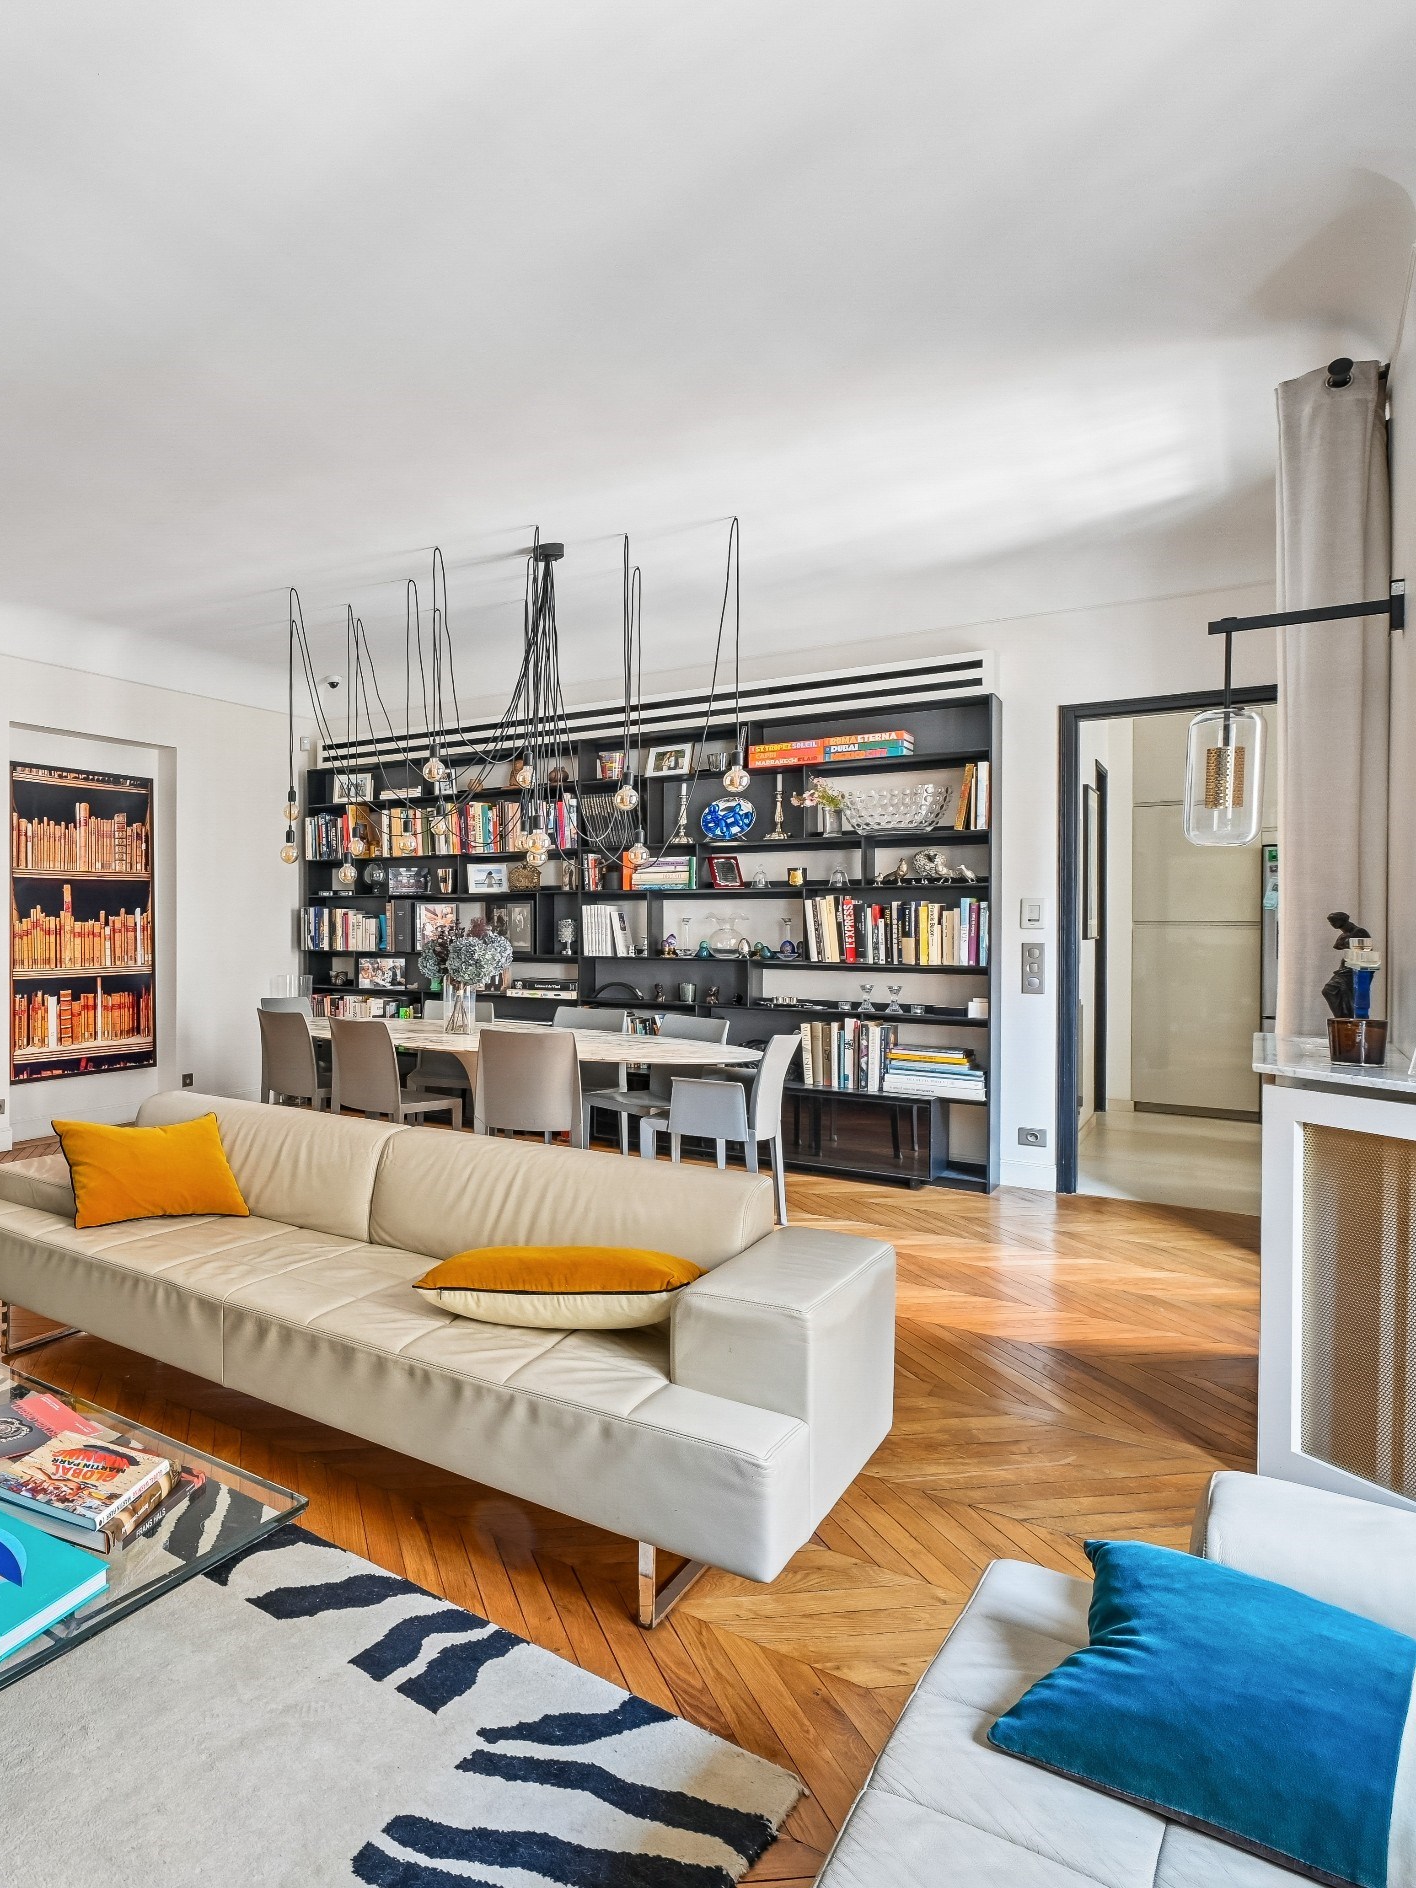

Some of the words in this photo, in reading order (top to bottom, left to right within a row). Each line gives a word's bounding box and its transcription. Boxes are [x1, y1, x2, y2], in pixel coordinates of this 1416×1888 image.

[856, 731, 897, 743] ETERNA
[830, 744, 858, 753] DUBAI
[755, 757, 797, 767] MARRAKECH
[843, 904, 856, 948] L'EXPRESS
[51, 1457, 80, 1467] PARR
[51, 1463, 120, 1483] GLOBAL
[82, 1463, 127, 1474] MARTIN
[136, 1519, 153, 1538] FRANS
[153, 1508, 166, 1526] HALS
